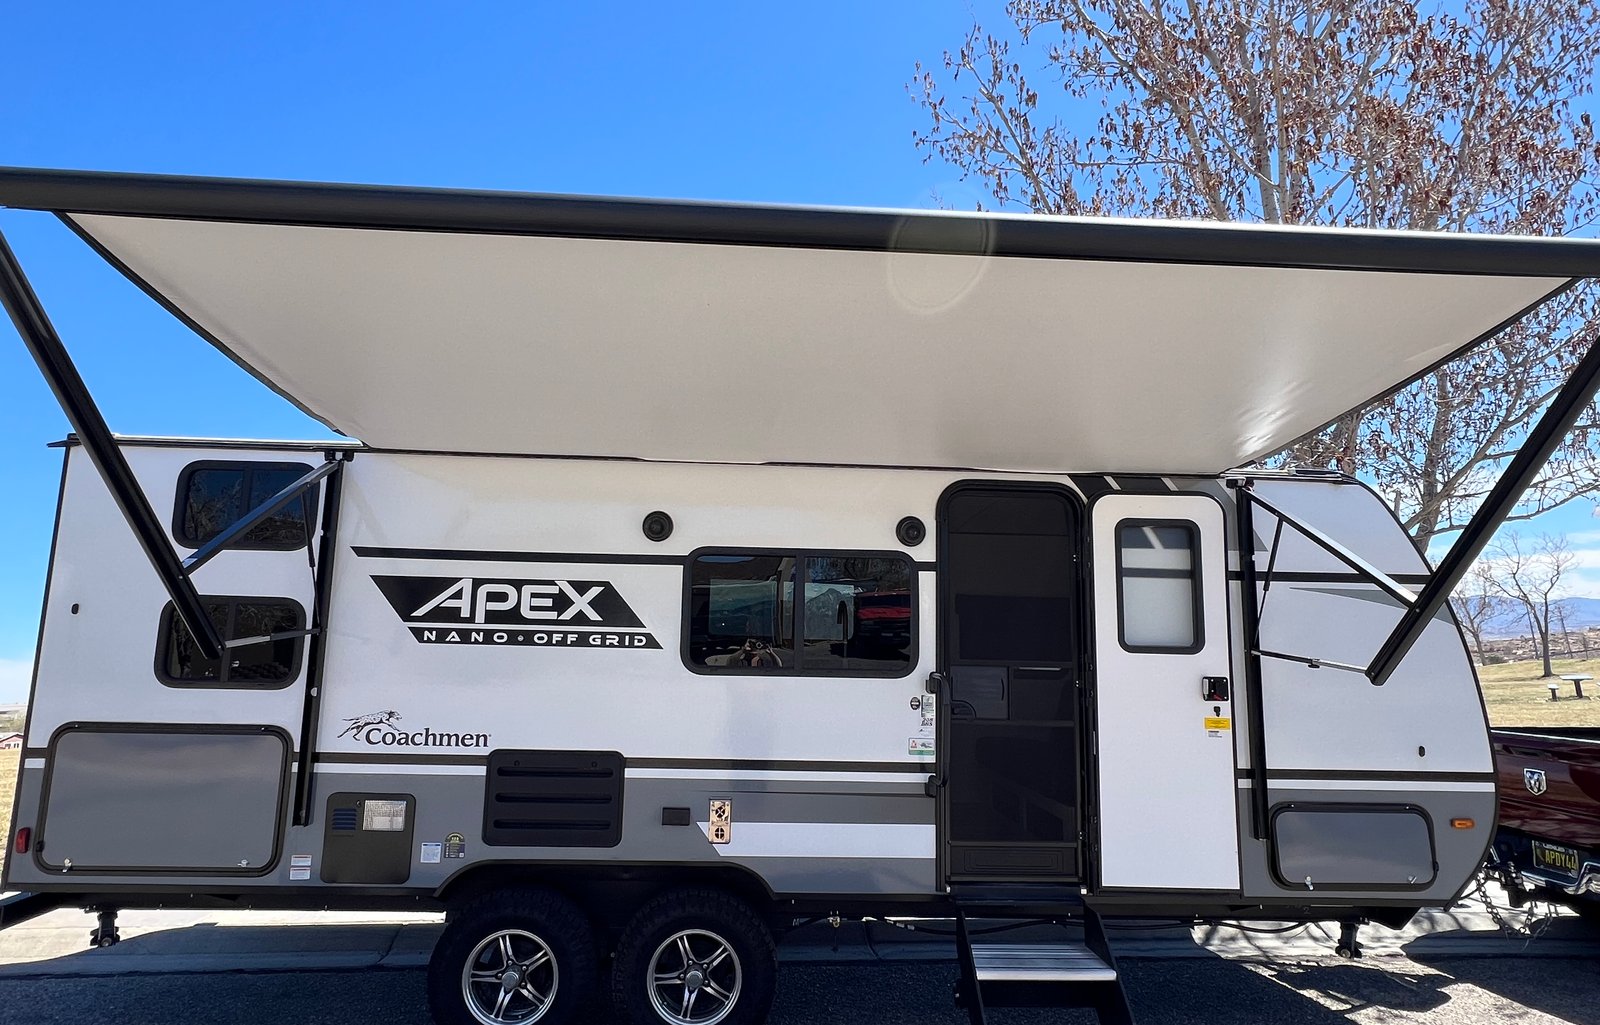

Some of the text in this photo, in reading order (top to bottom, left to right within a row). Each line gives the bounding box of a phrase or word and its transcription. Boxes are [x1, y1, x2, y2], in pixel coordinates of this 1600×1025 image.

[410, 578, 605, 623] APEX
[423, 630, 647, 647] NANO OFF GRID
[365, 728, 489, 748] Coachmen
